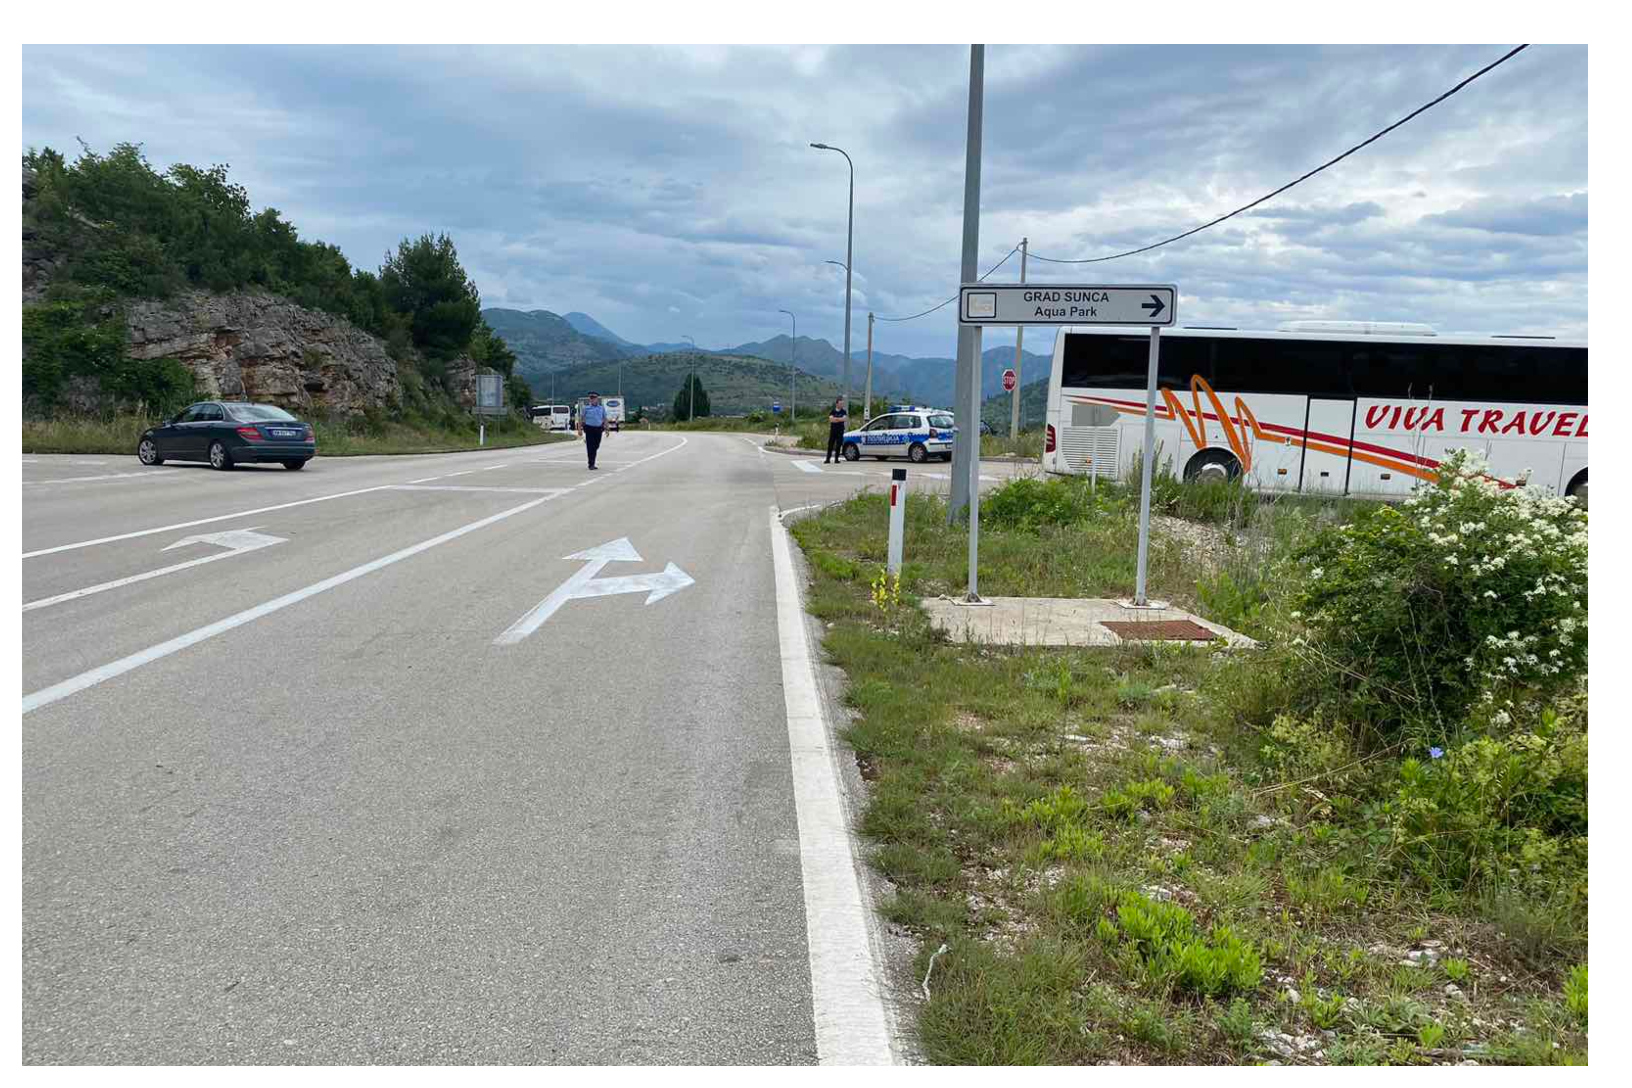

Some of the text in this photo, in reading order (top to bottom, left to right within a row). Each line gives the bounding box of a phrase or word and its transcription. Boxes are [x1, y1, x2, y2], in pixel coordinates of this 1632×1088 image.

[1023, 292, 1110, 303] GRAD SUNCA
[1034, 306, 1097, 318] Aqua Park
[1365, 405, 1445, 431] VIVA
